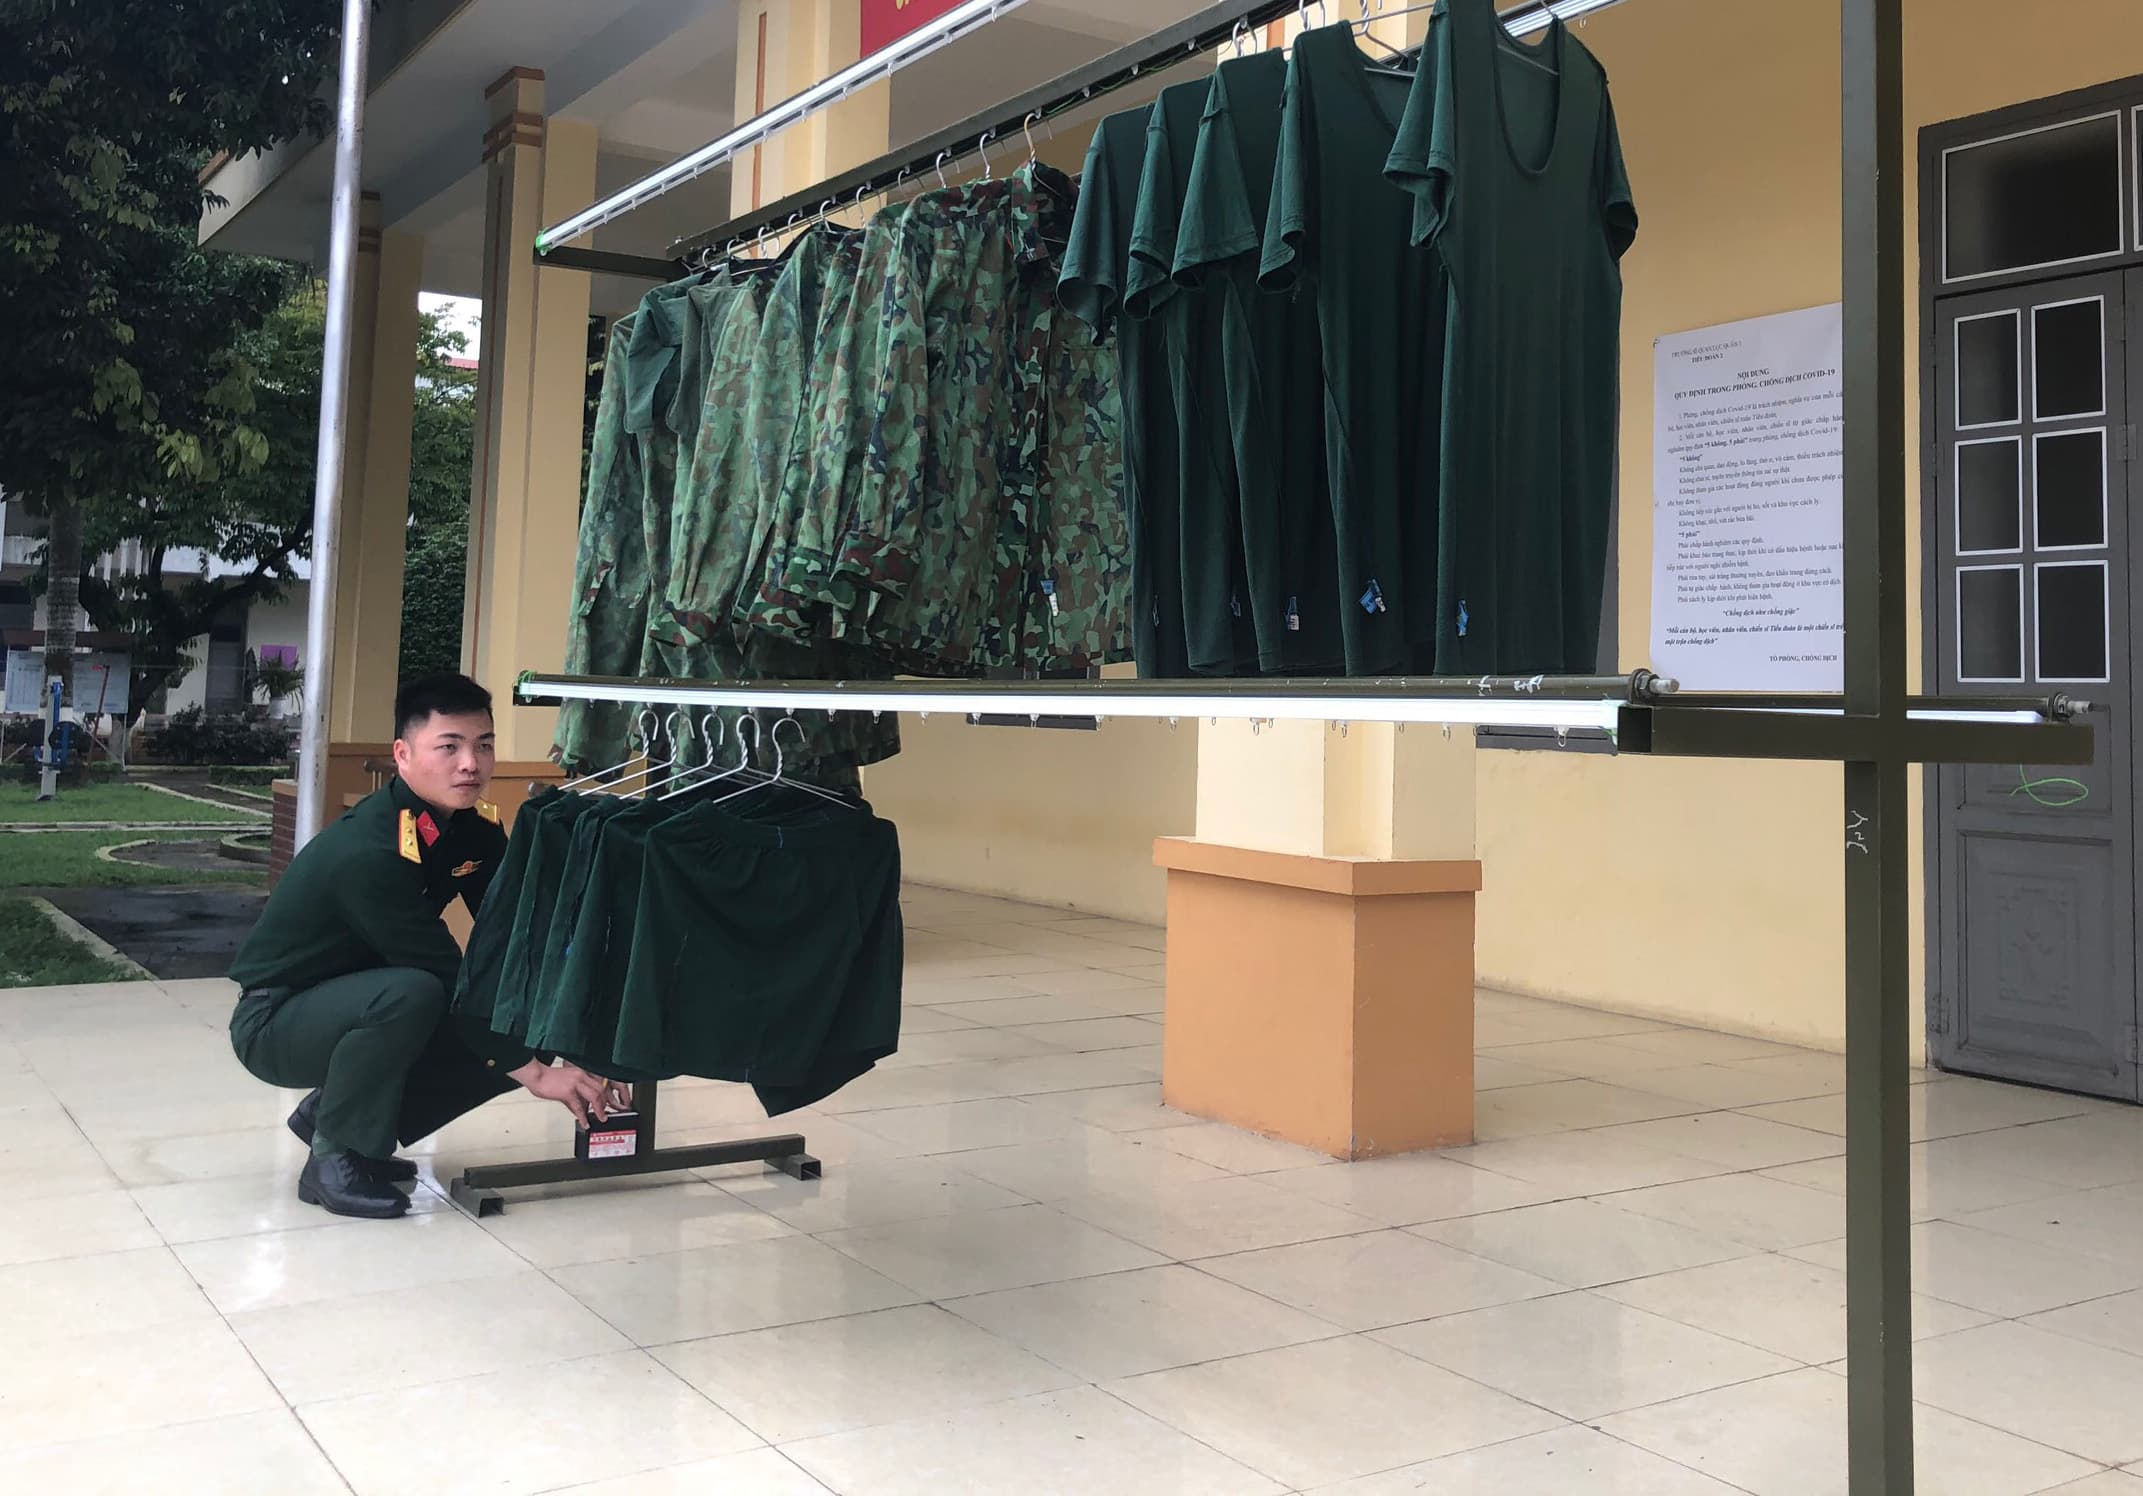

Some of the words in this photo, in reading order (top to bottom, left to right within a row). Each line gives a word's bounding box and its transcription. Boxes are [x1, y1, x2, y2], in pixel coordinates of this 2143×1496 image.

[1706, 383, 1730, 395] TRONG
[1802, 367, 1835, 381] COVID-19
[1750, 366, 1769, 378] DUNG
